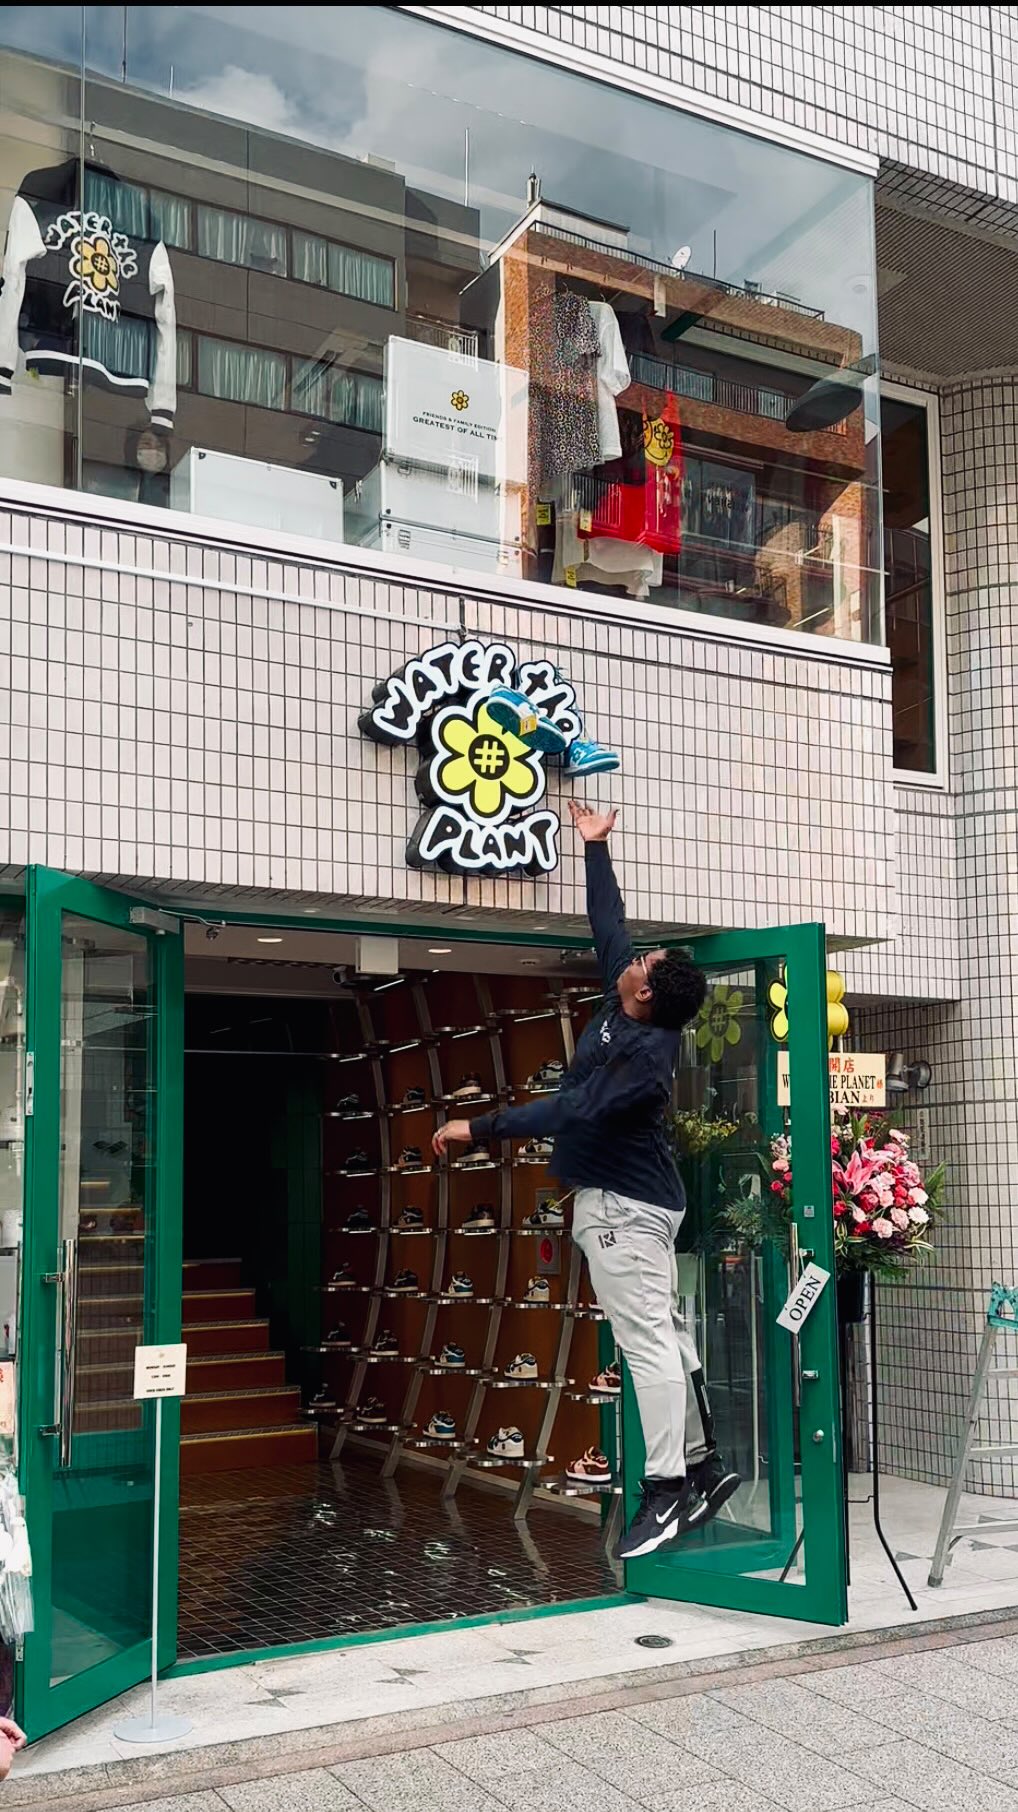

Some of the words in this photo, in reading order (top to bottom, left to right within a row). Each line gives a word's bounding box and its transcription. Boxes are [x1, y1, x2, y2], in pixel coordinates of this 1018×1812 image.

[45, 211, 113, 251] WATER
[63, 280, 120, 322] PLAN
[412, 416, 455, 431] GREATEST
[469, 430, 485, 439] ALL
[422, 412, 447, 421] FRIENDS
[453, 418, 473, 427] FAMILY
[474, 423, 496, 432] EDITION
[373, 641, 515, 739] WATER
[419, 806, 560, 871] PLANT
[828, 1057, 855, 1074] 開店
[829, 1090, 861, 1104] BIAN
[841, 1075, 876, 1089] PLANET
[788, 1274, 821, 1321] OPEN
